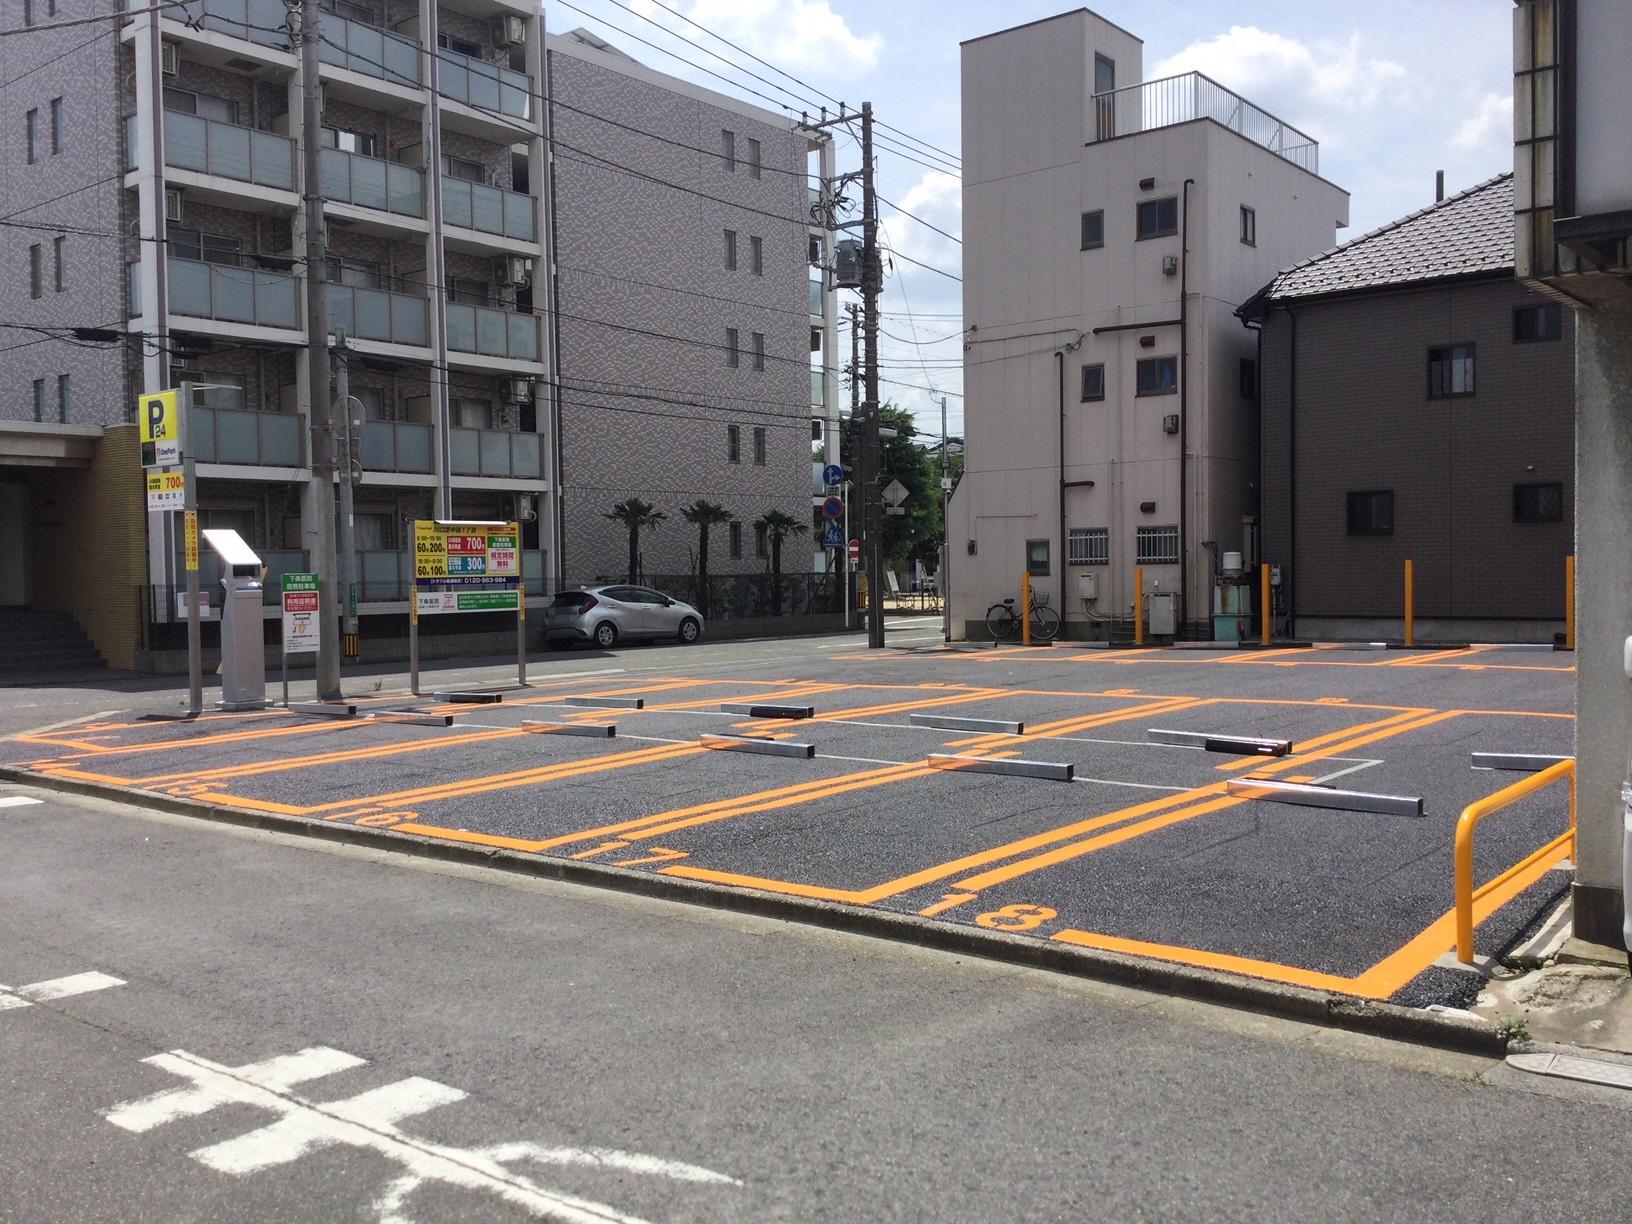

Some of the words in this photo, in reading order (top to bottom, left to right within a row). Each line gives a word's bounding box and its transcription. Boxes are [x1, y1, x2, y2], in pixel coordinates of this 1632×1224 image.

[148, 400, 164, 438] P
[155, 424, 166, 438] 24
[570, 841, 690, 867] 17
[919, 892, 1058, 932] 18
